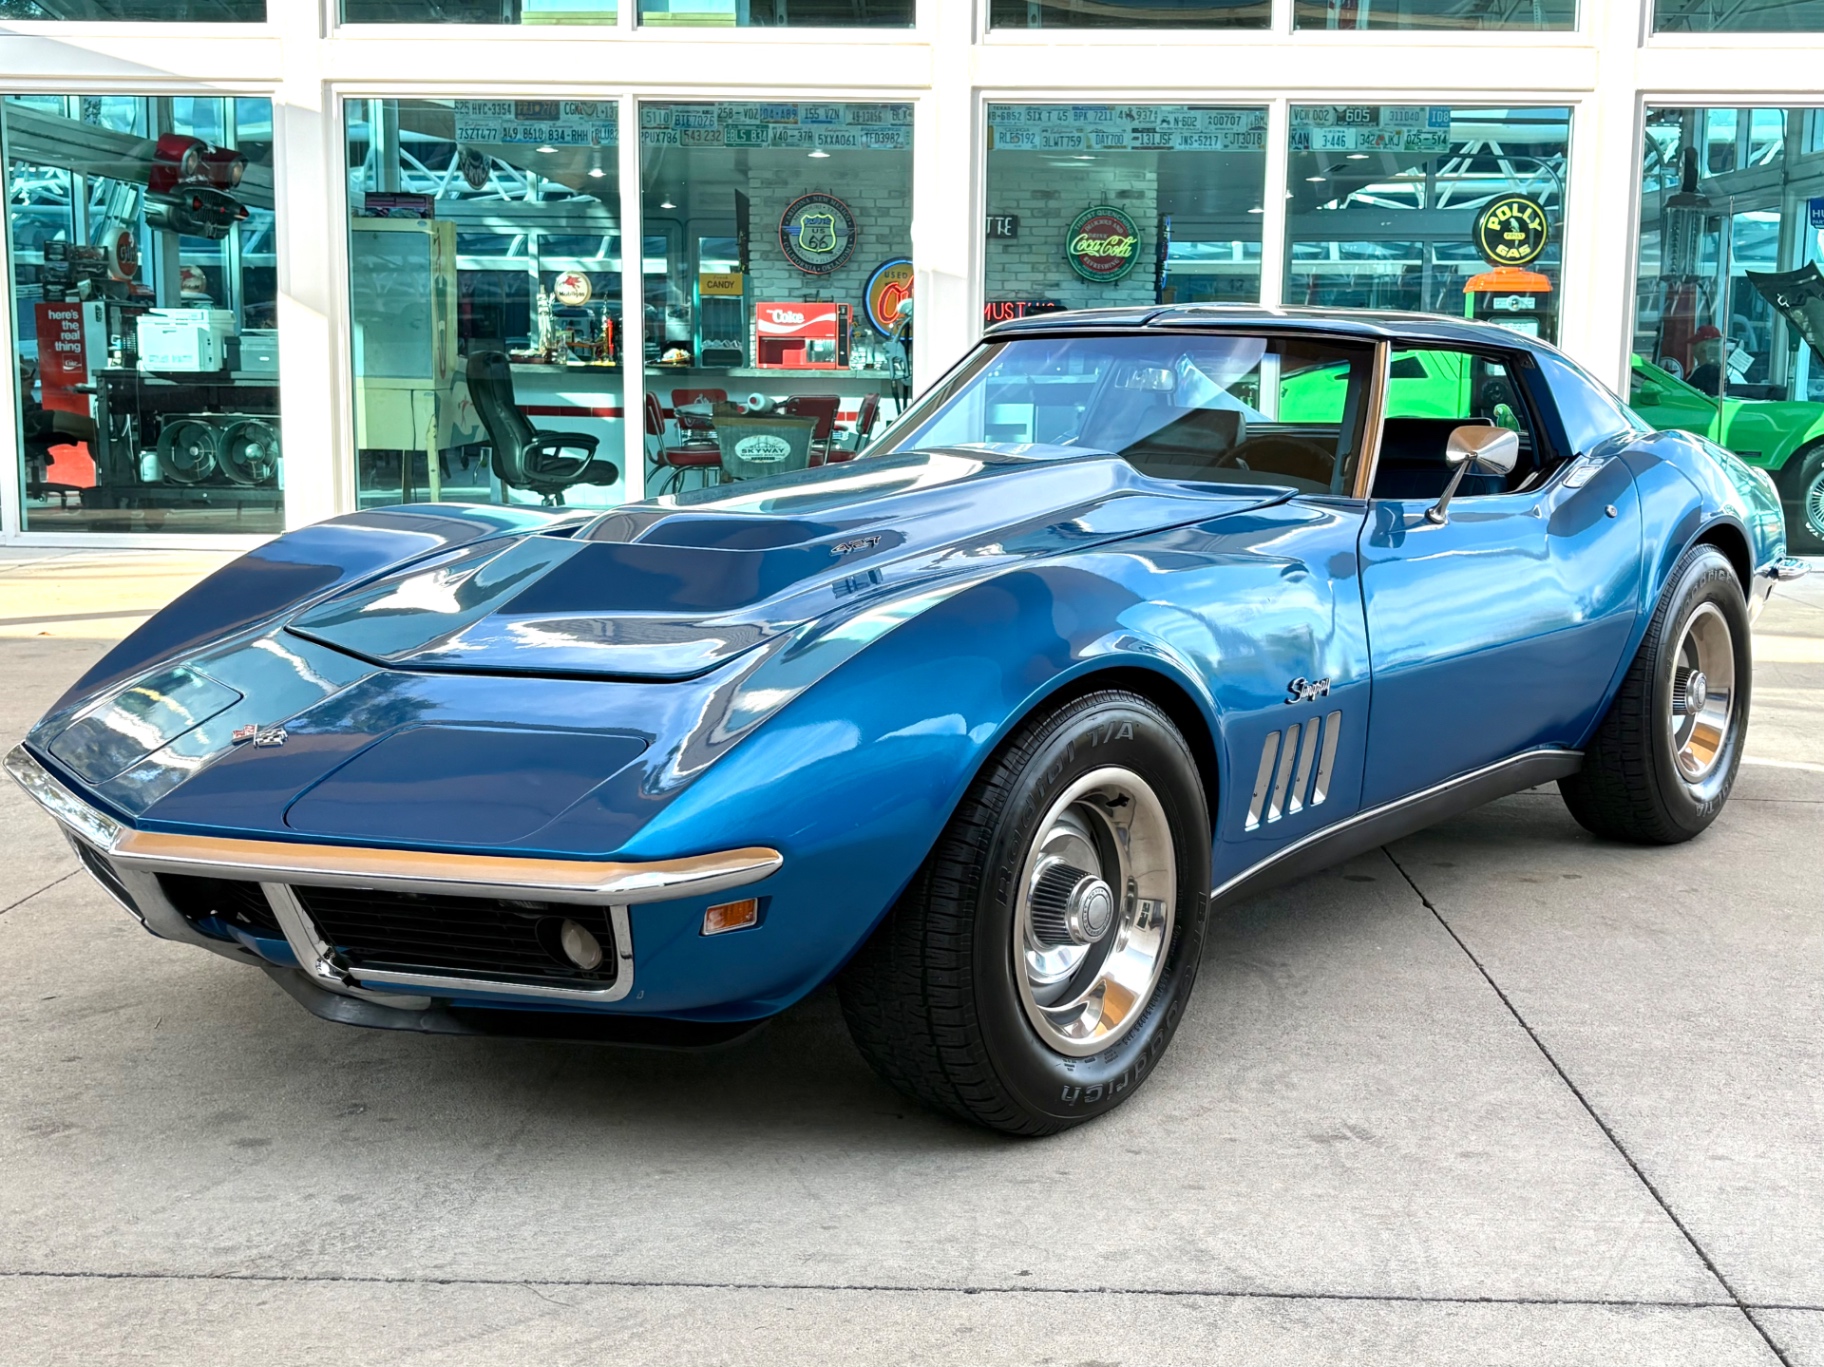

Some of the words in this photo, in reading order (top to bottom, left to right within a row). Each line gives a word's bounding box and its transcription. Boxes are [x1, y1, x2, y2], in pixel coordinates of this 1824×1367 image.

[1345, 109, 1371, 122] 605
[1073, 211, 1095, 231] THIRST
[1096, 209, 1134, 235] QUENCHING
[1486, 203, 1542, 232] POLLY
[809, 235, 829, 249] 66
[1495, 244, 1532, 259] GAS
[884, 271, 908, 279] USED
[706, 281, 735, 289] CANDY
[48, 309, 79, 320] here's
[772, 309, 805, 324] Coke
[62, 320, 79, 331] the
[61, 331, 80, 341] real
[55, 341, 81, 353] thing
[1086, 720, 1135, 749] T/A
